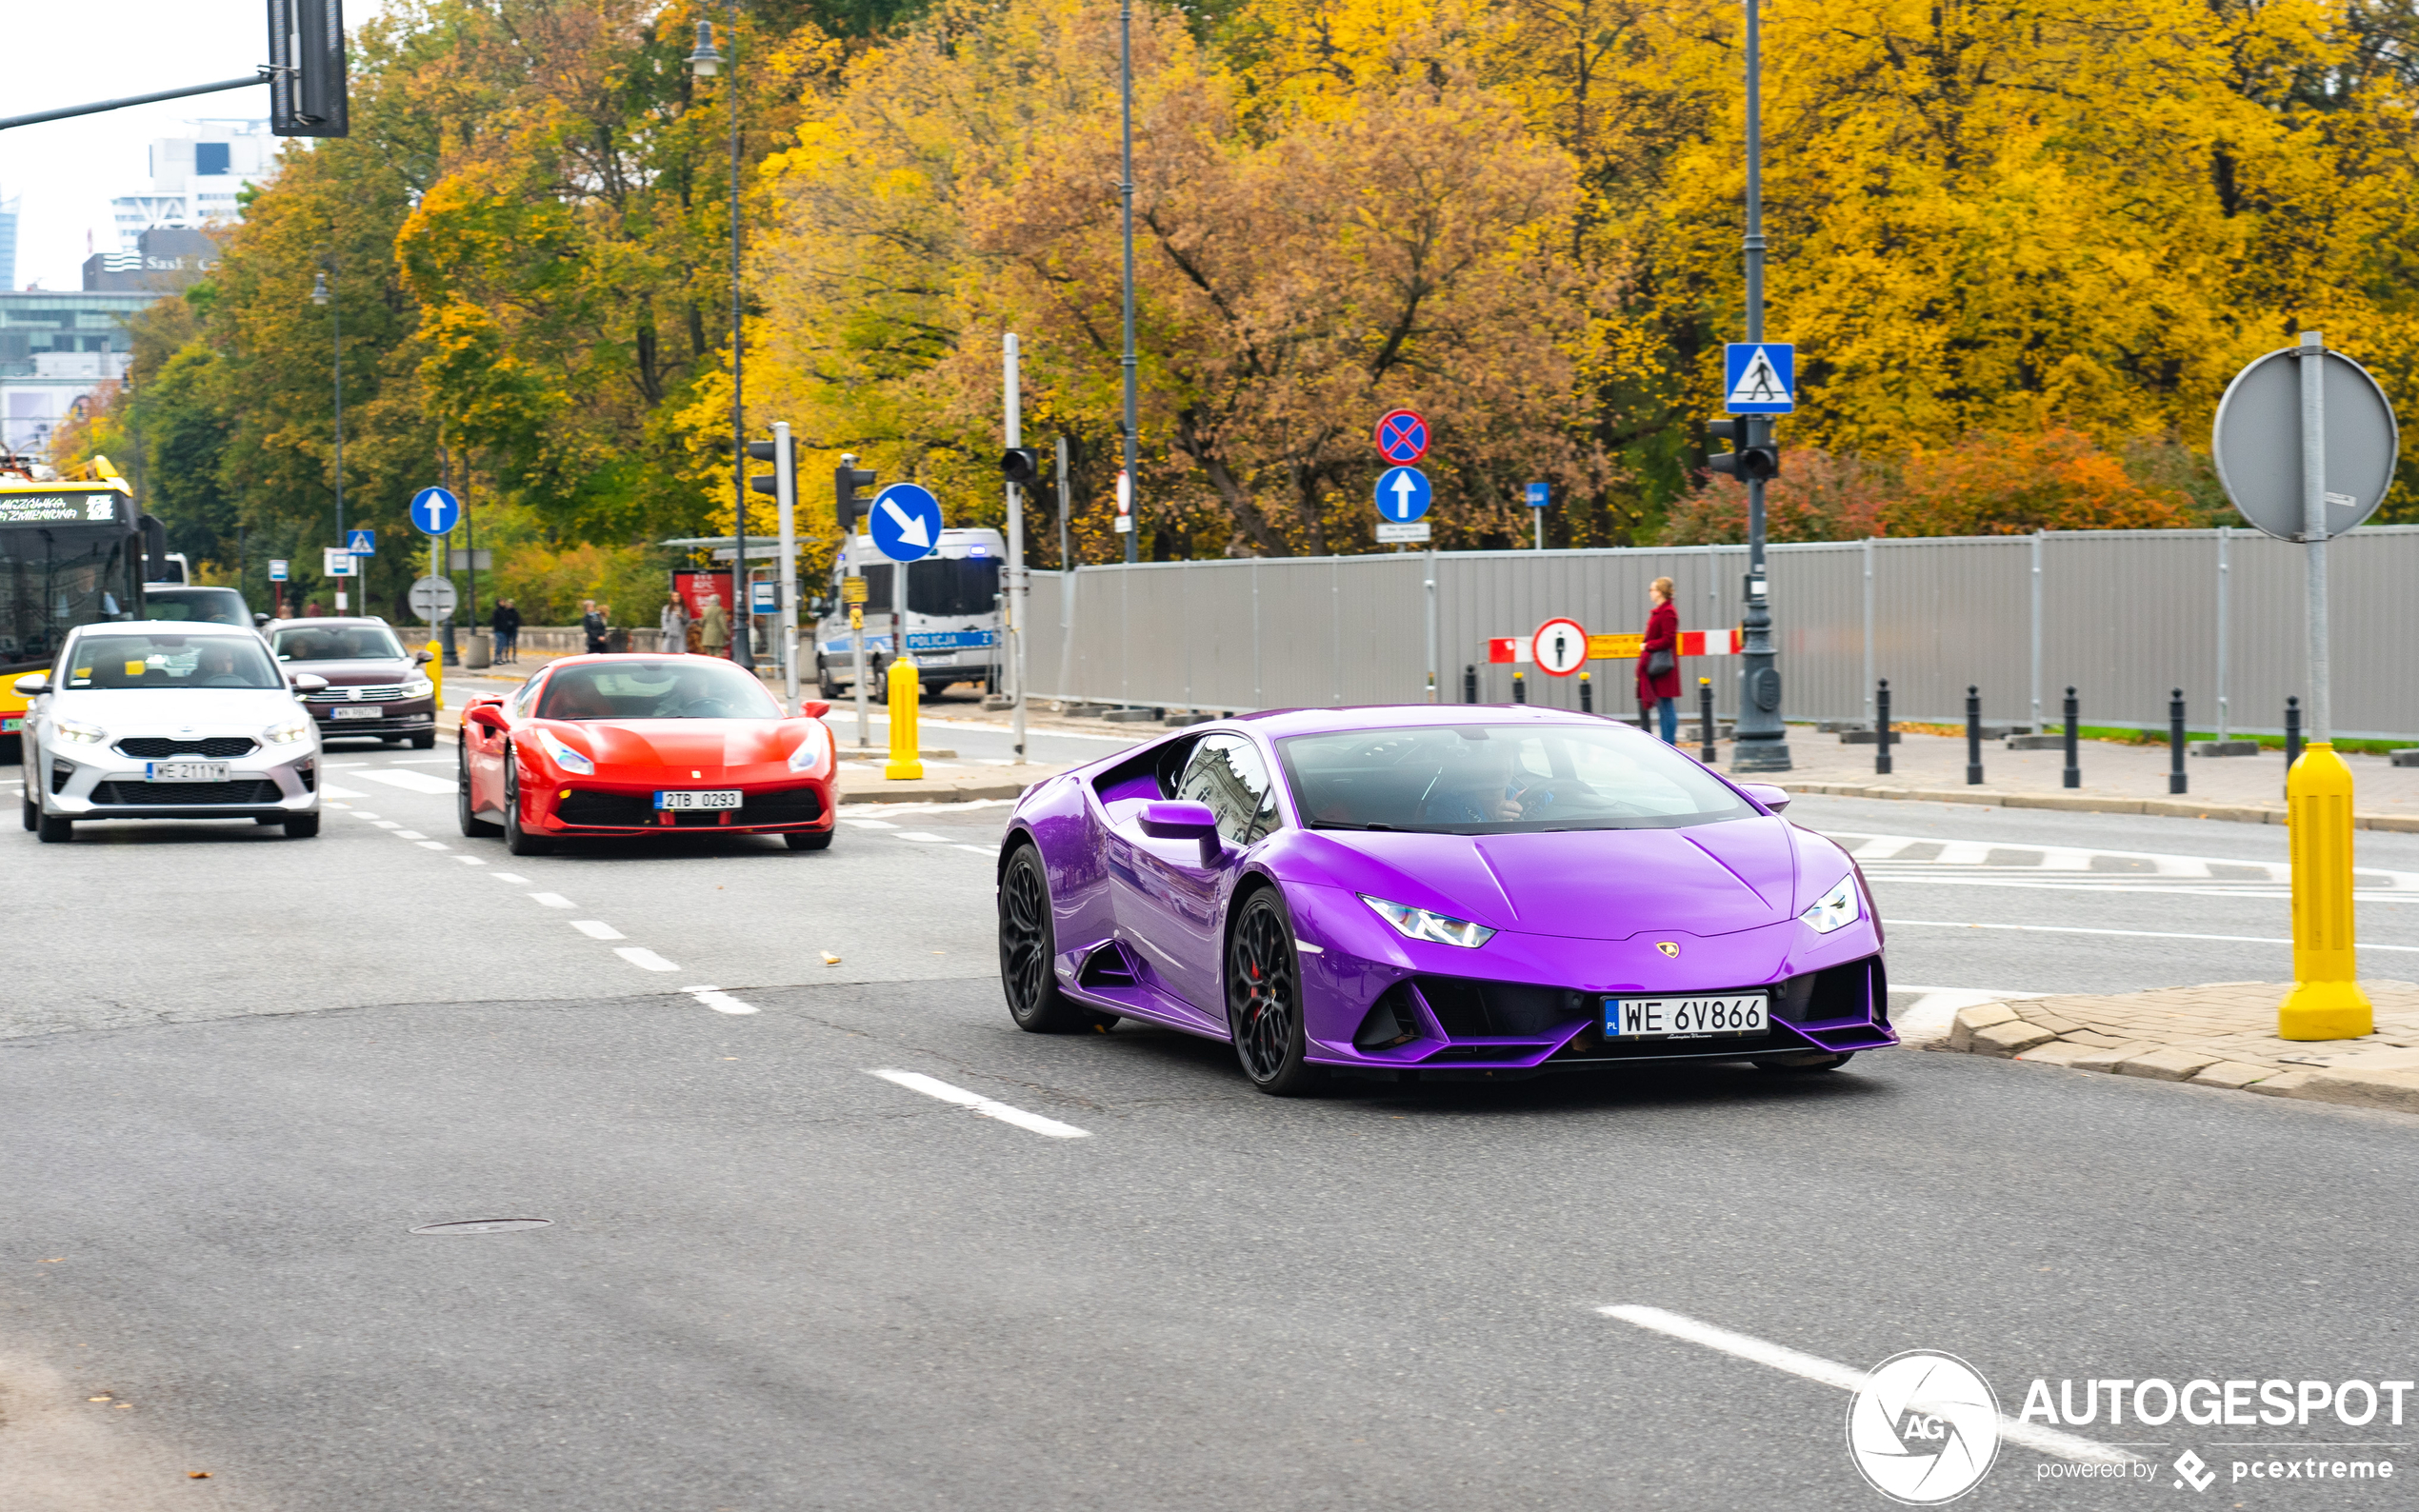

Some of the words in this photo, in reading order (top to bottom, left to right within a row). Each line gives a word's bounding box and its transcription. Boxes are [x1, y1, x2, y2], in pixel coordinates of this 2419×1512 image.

[909, 634, 957, 647] POLICJA
[156, 764, 175, 778] WE
[667, 793, 692, 806] 2TB
[702, 793, 736, 806] 0293
[1607, 1022, 1617, 1030] PL
[1625, 1002, 1663, 1032] WE
[1674, 999, 1760, 1030] 6V866
